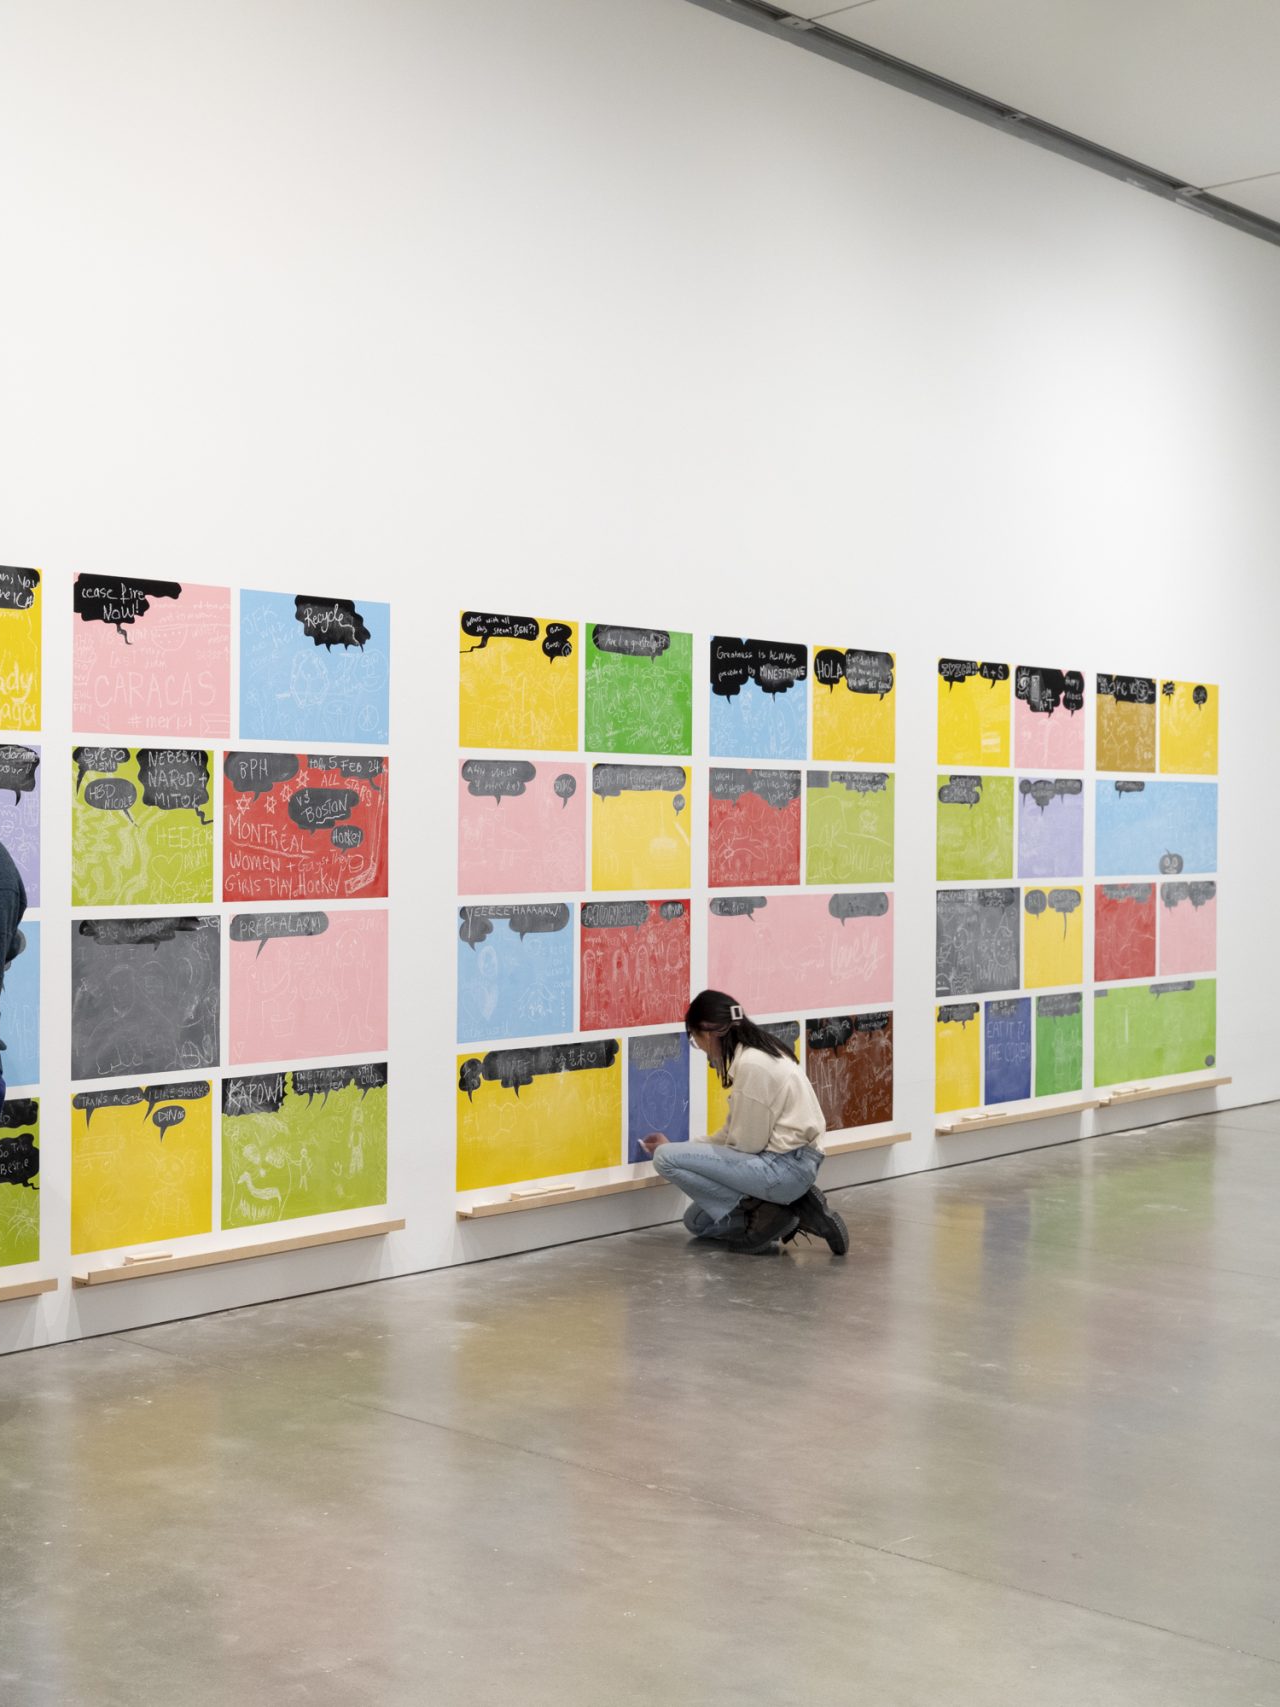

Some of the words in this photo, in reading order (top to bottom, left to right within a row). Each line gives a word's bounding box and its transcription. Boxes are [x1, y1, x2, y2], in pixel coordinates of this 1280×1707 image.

[304, 603, 347, 634] Recycle
[816, 658, 843, 681] HOLA
[94, 669, 217, 709] CARACAS
[238, 757, 270, 780] BPH
[368, 760, 381, 773] 24
[320, 774, 341, 787] ALL
[89, 784, 116, 801] HBD
[300, 793, 349, 824] BOSTON
